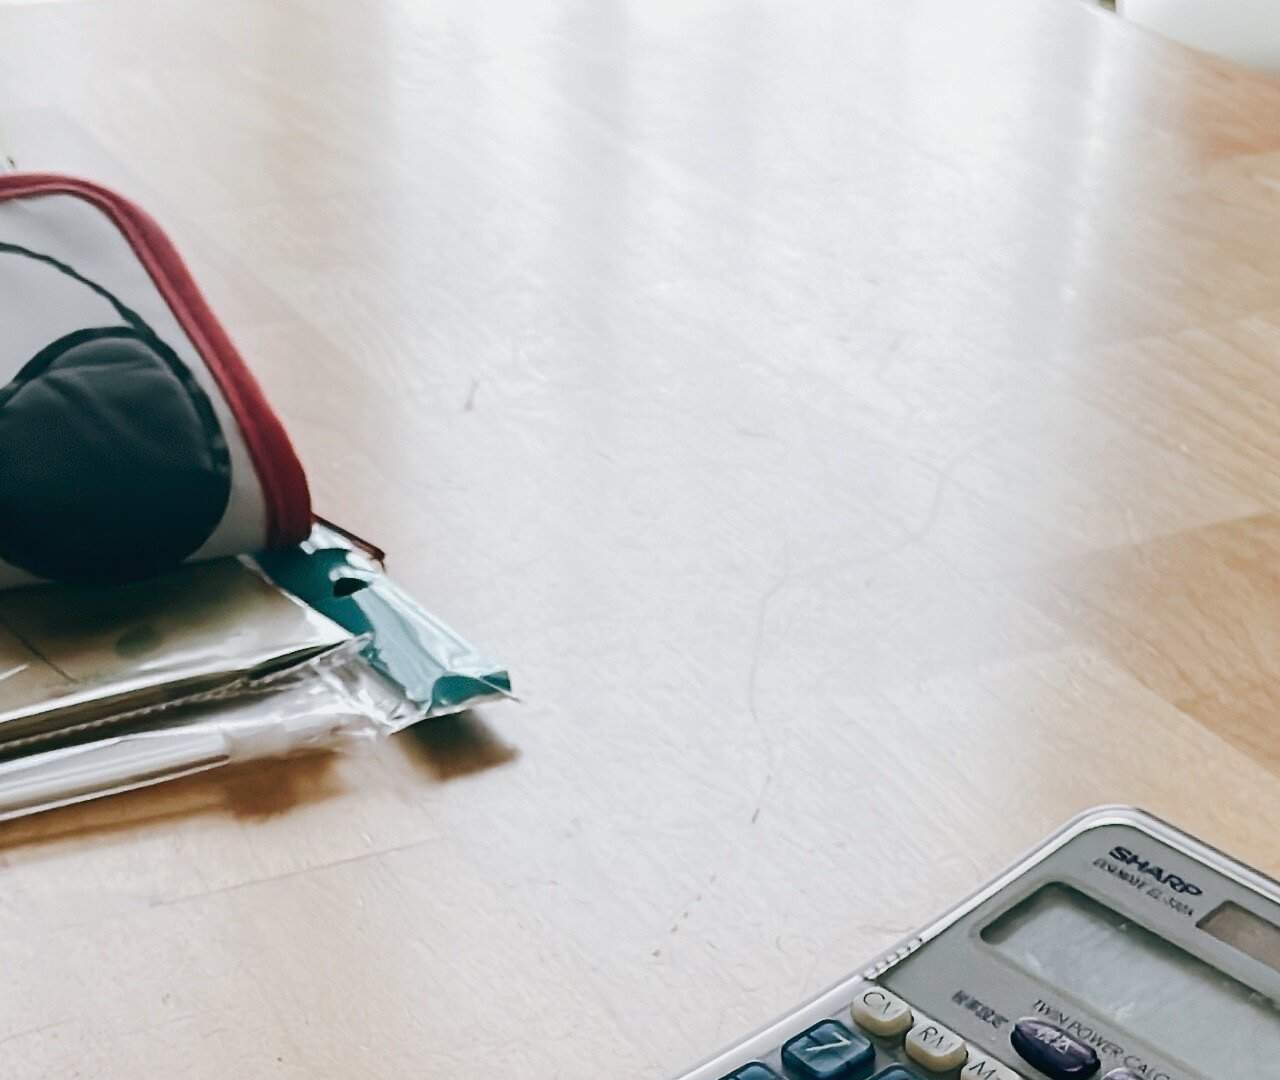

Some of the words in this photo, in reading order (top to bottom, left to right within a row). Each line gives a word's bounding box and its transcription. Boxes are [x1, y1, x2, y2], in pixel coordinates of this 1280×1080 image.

[1108, 846, 1203, 896] SHARP
[806, 1031, 851, 1052] 7
[1067, 1017, 1124, 1058] POWER
